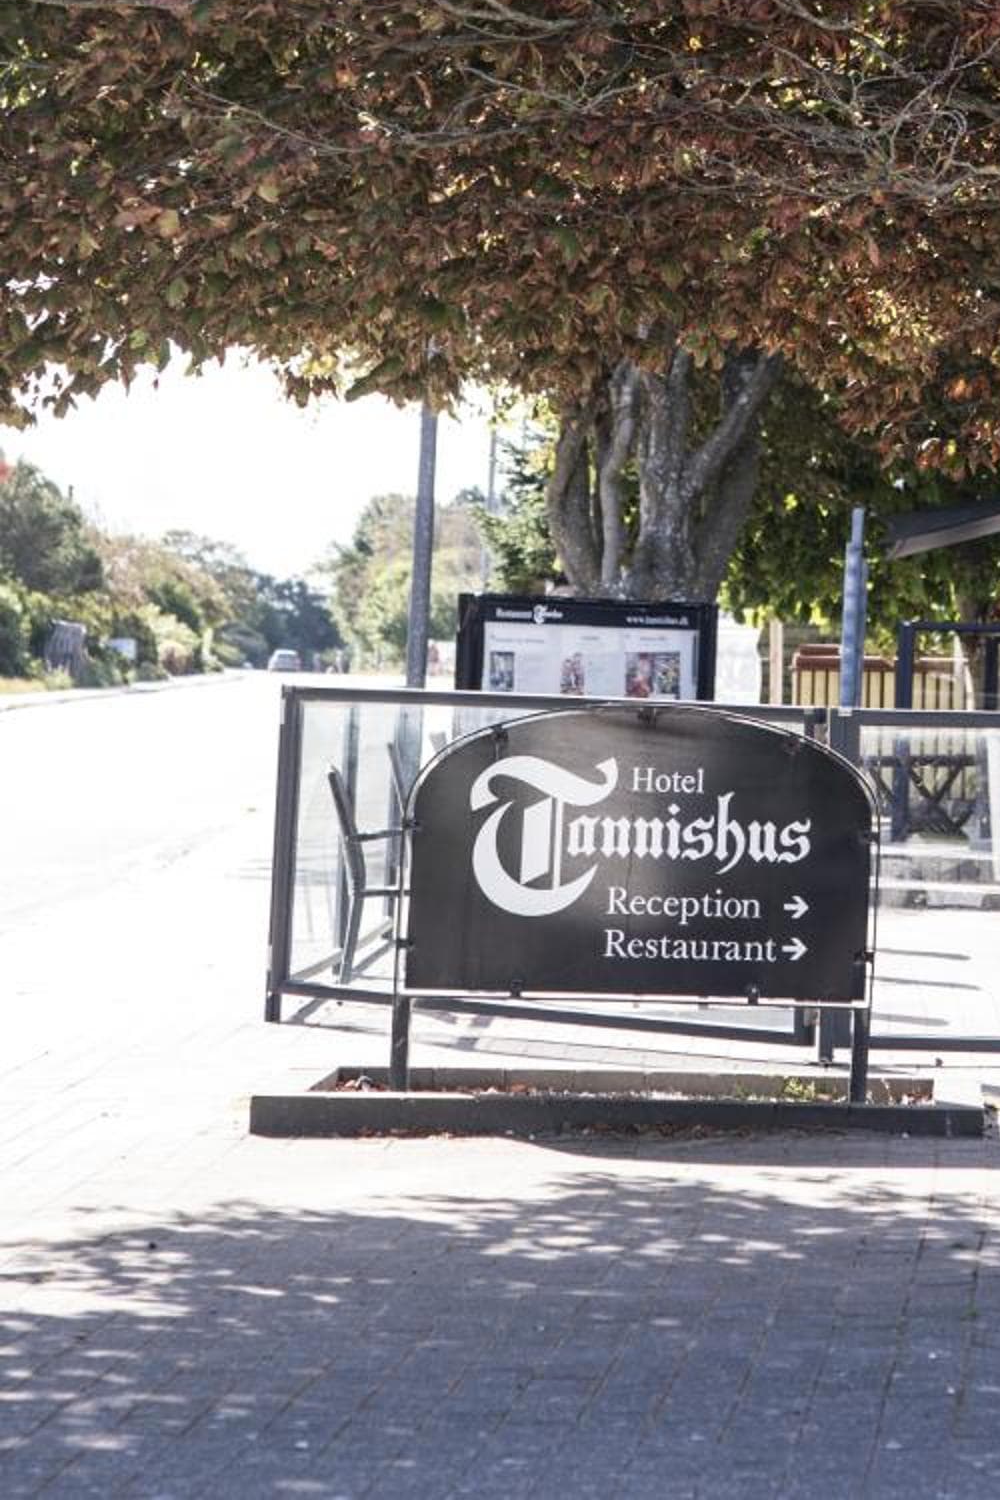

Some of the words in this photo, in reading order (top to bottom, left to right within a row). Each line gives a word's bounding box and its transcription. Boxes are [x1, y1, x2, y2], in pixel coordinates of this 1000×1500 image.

[632, 766, 704, 794] Hotel
[470, 755, 812, 917] Tannishus
[606, 885, 761, 925] Reception
[604, 929, 777, 962] Restaurant
